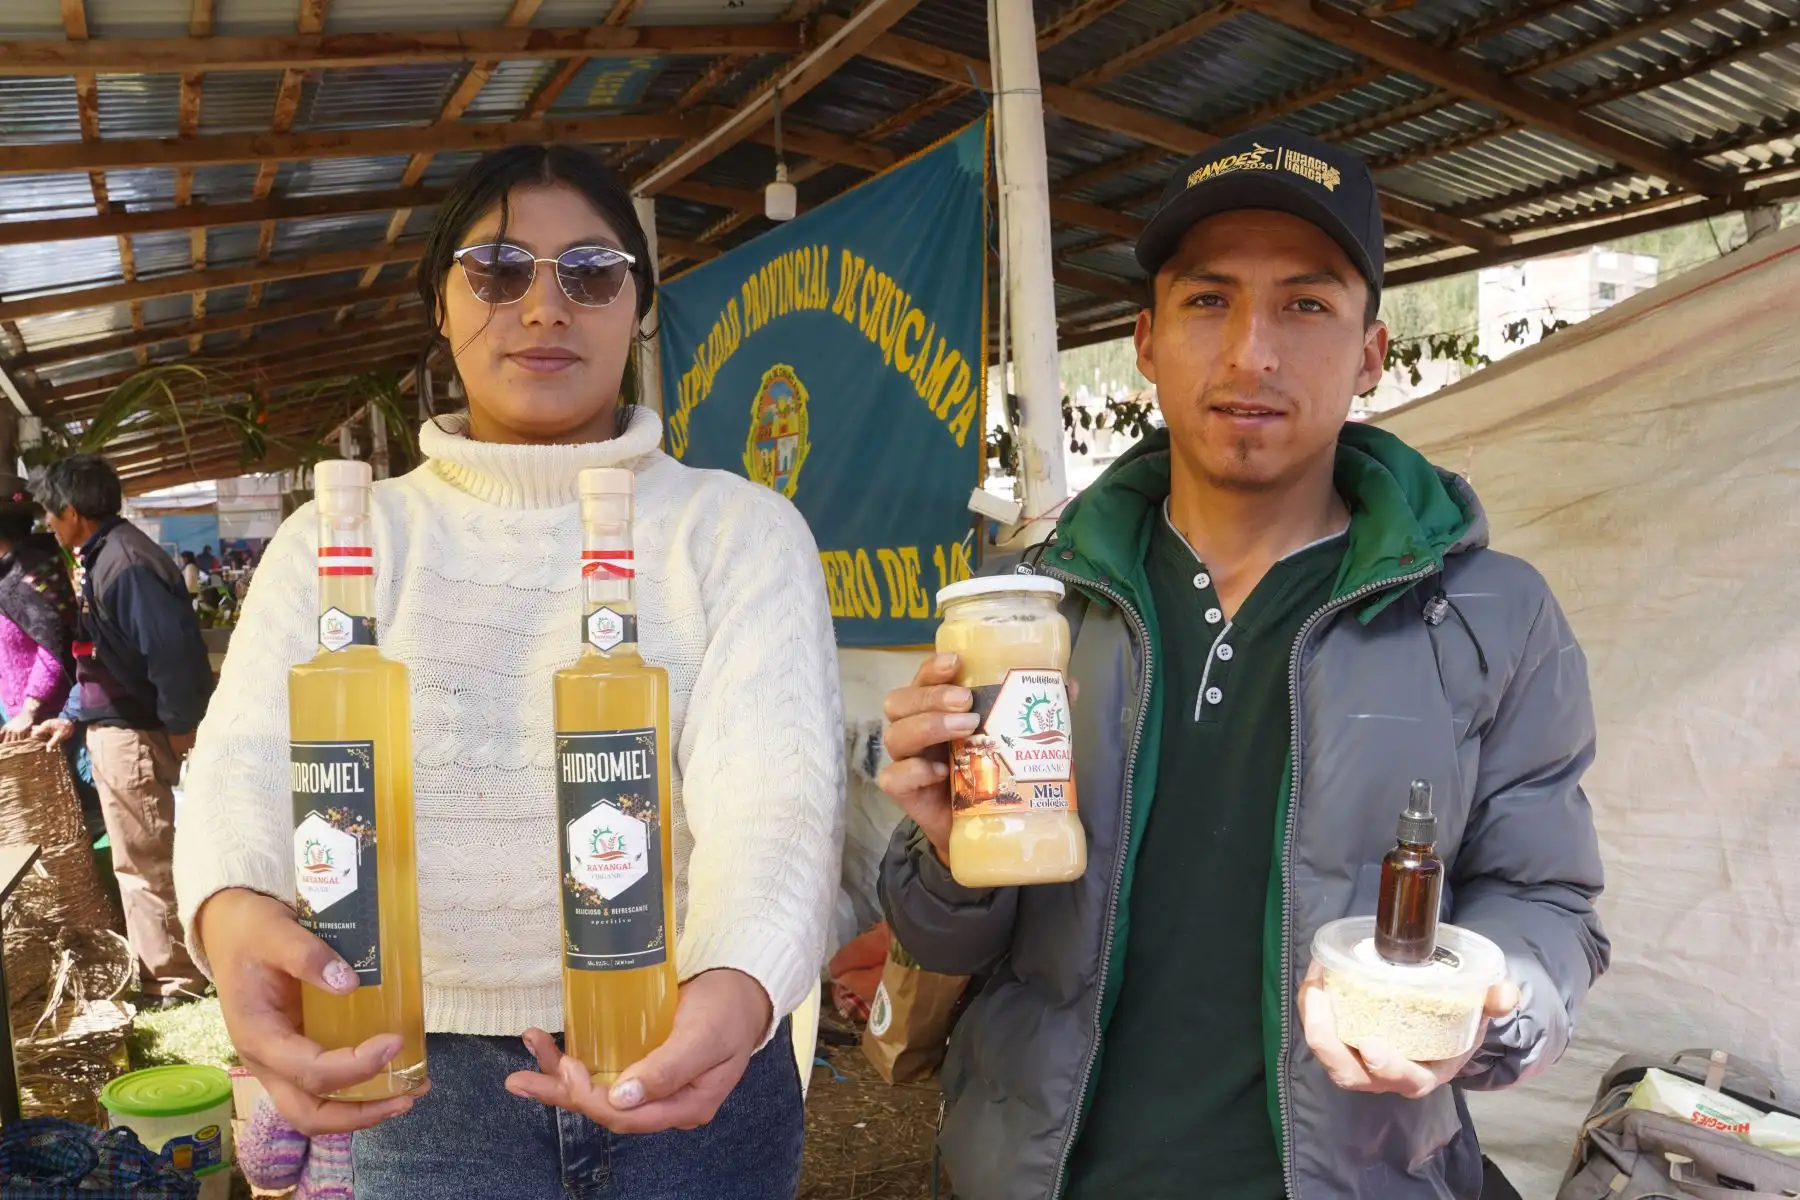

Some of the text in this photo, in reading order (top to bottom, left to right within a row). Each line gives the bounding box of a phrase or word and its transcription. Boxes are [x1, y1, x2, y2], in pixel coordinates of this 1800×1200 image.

[1200, 151, 1262, 183] ANDES
[1243, 162, 1273, 170] 2026
[832, 249, 865, 324] DE
[819, 548, 882, 619] ERO
[876, 546, 930, 619] DE
[562, 749, 651, 783] HIDROMIEL
[1033, 783, 1064, 799] Miel
